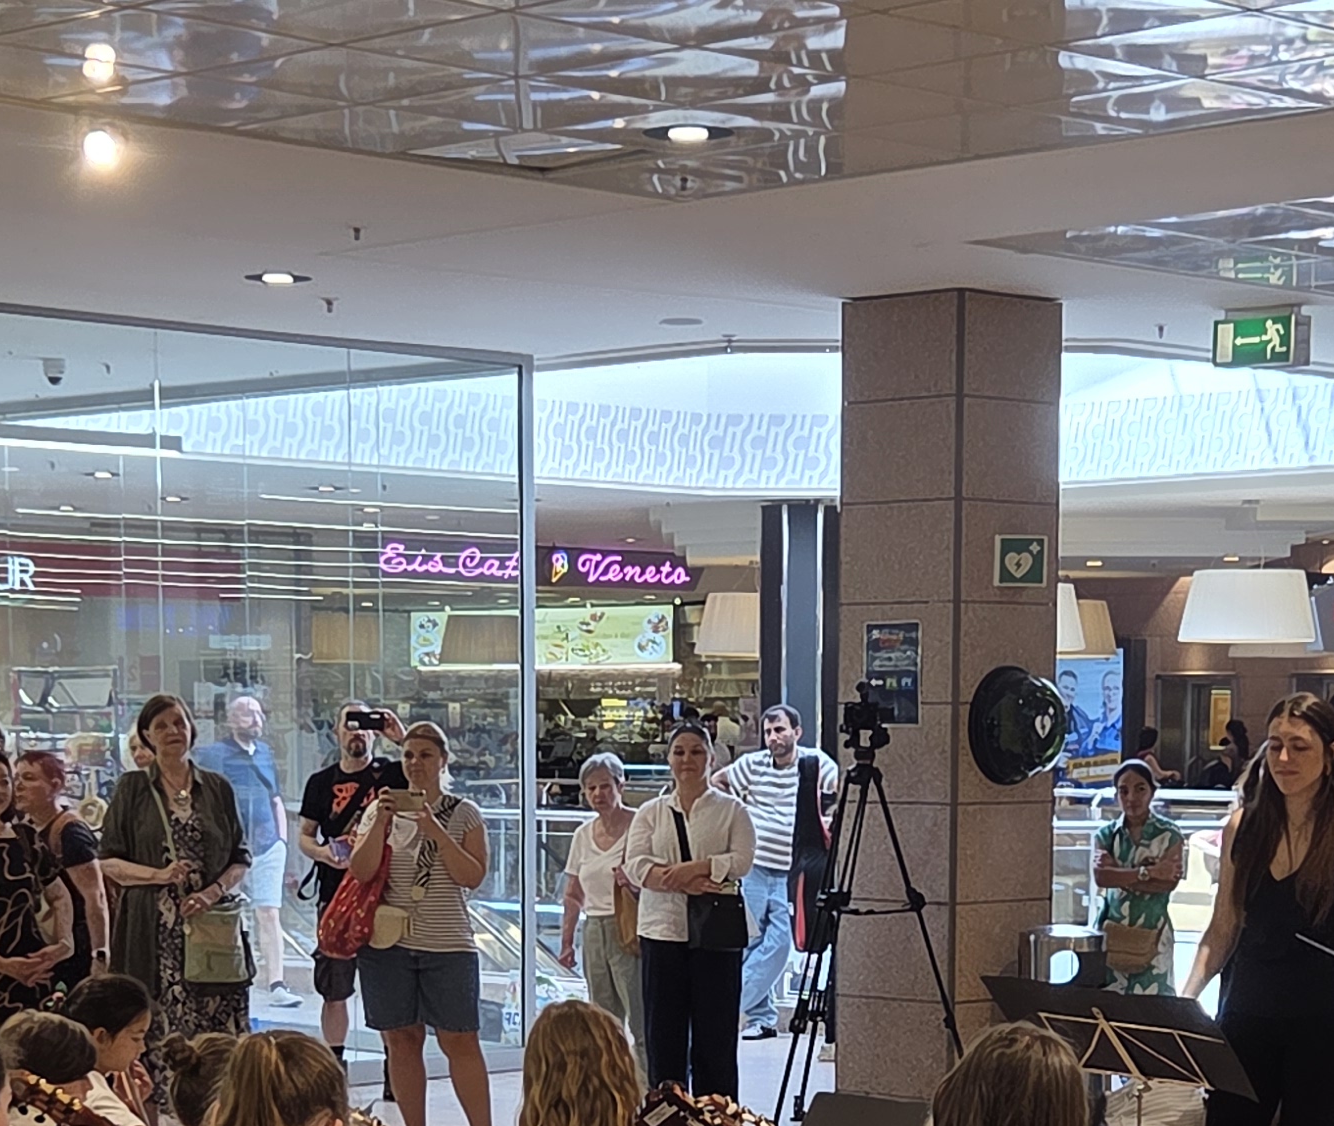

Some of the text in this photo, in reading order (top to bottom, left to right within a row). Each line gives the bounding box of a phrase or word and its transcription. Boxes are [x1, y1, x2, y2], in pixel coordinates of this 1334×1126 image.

[379, 543, 520, 579] Eis Caf
[577, 553, 691, 585] Veneto
